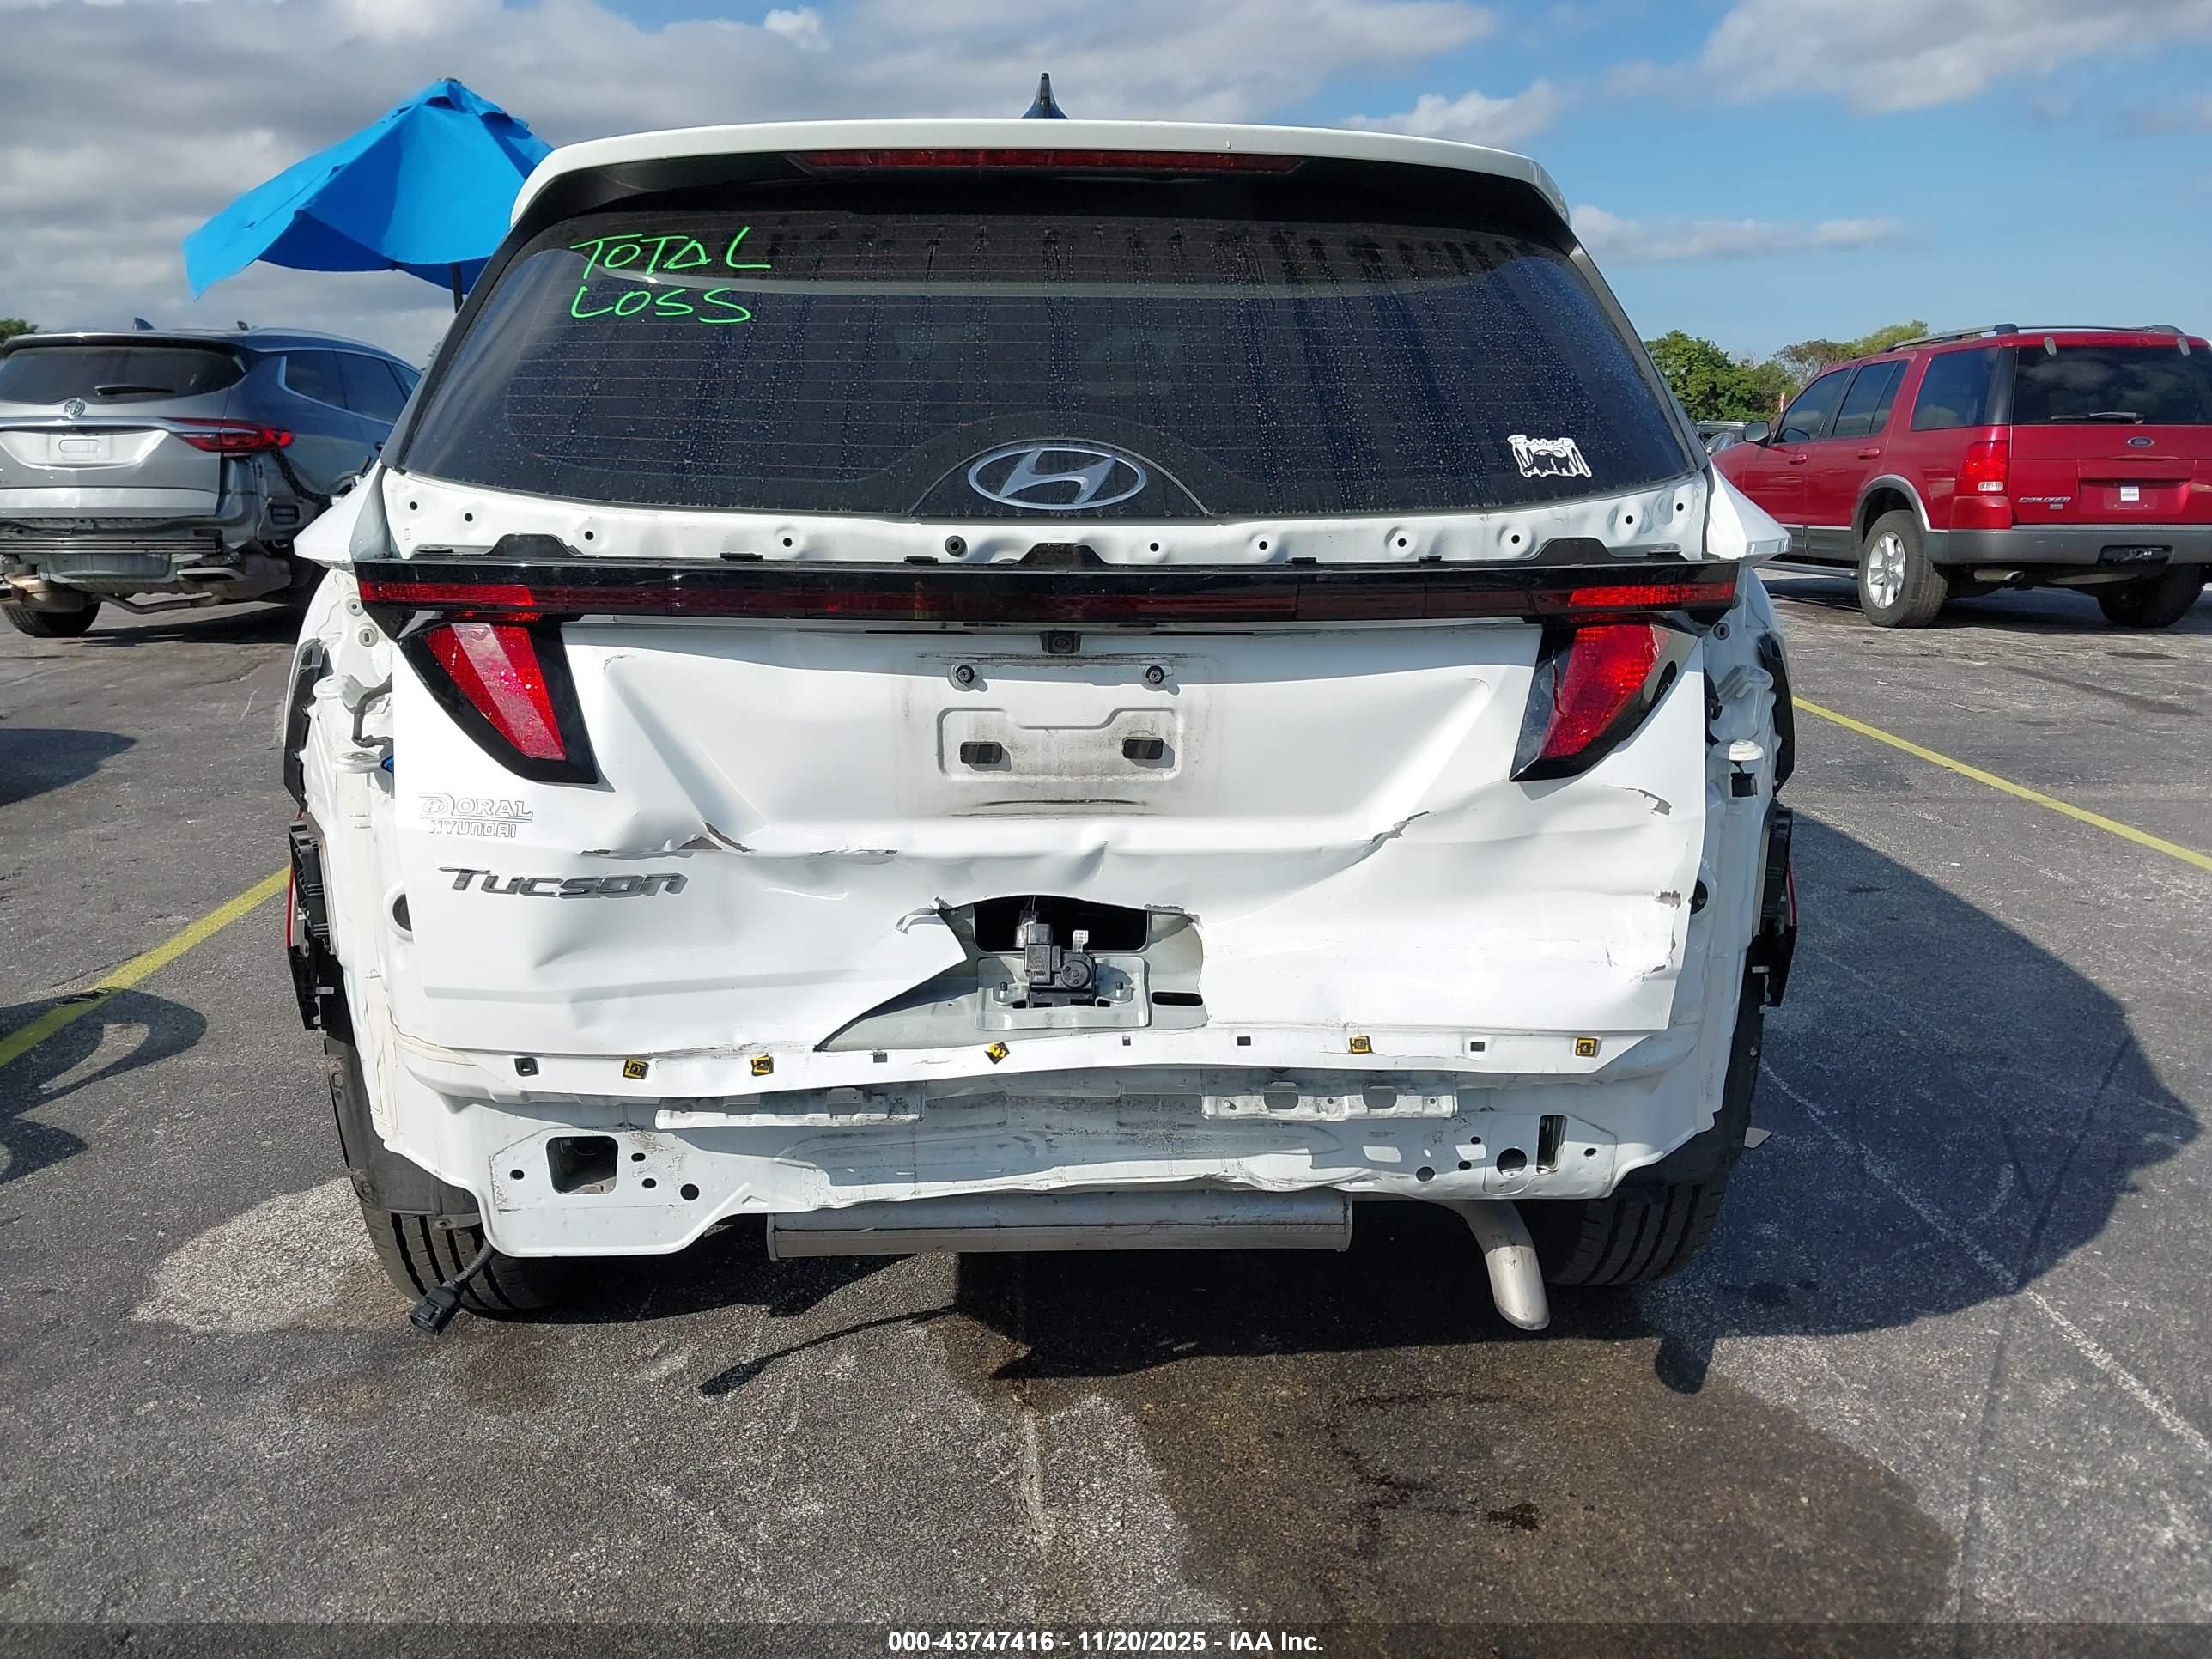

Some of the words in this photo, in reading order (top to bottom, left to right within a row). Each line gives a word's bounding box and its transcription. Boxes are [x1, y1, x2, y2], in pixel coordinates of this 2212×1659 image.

[570, 226, 772, 279] TOTAL
[570, 286, 752, 324] LOSS
[428, 819, 517, 839] HYUNDAI
